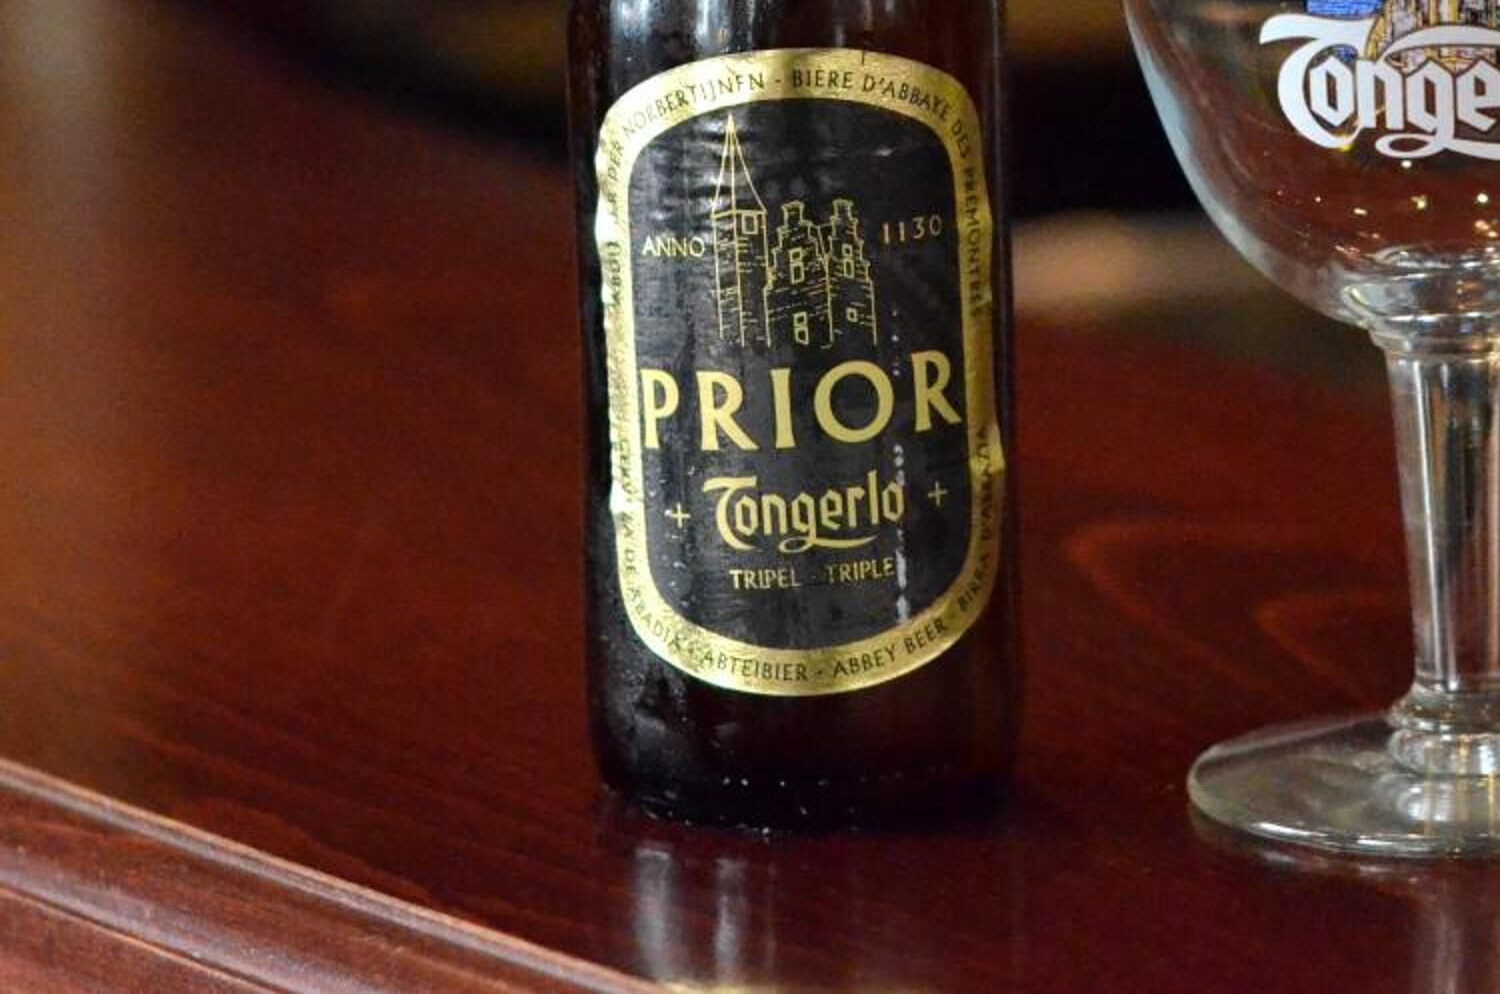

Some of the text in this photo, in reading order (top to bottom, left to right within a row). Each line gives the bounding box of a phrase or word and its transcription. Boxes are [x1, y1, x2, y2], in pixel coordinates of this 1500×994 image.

[641, 214, 943, 259] ANNO 1130
[640, 349, 963, 452] PRIOR
[702, 469, 904, 554] Tongerlo
[729, 556, 895, 590] TRIPEL TRIPLE
[702, 650, 809, 682] ABTEIBIER
[833, 643, 897, 679] ABBEY
[903, 617, 948, 655] BEER
